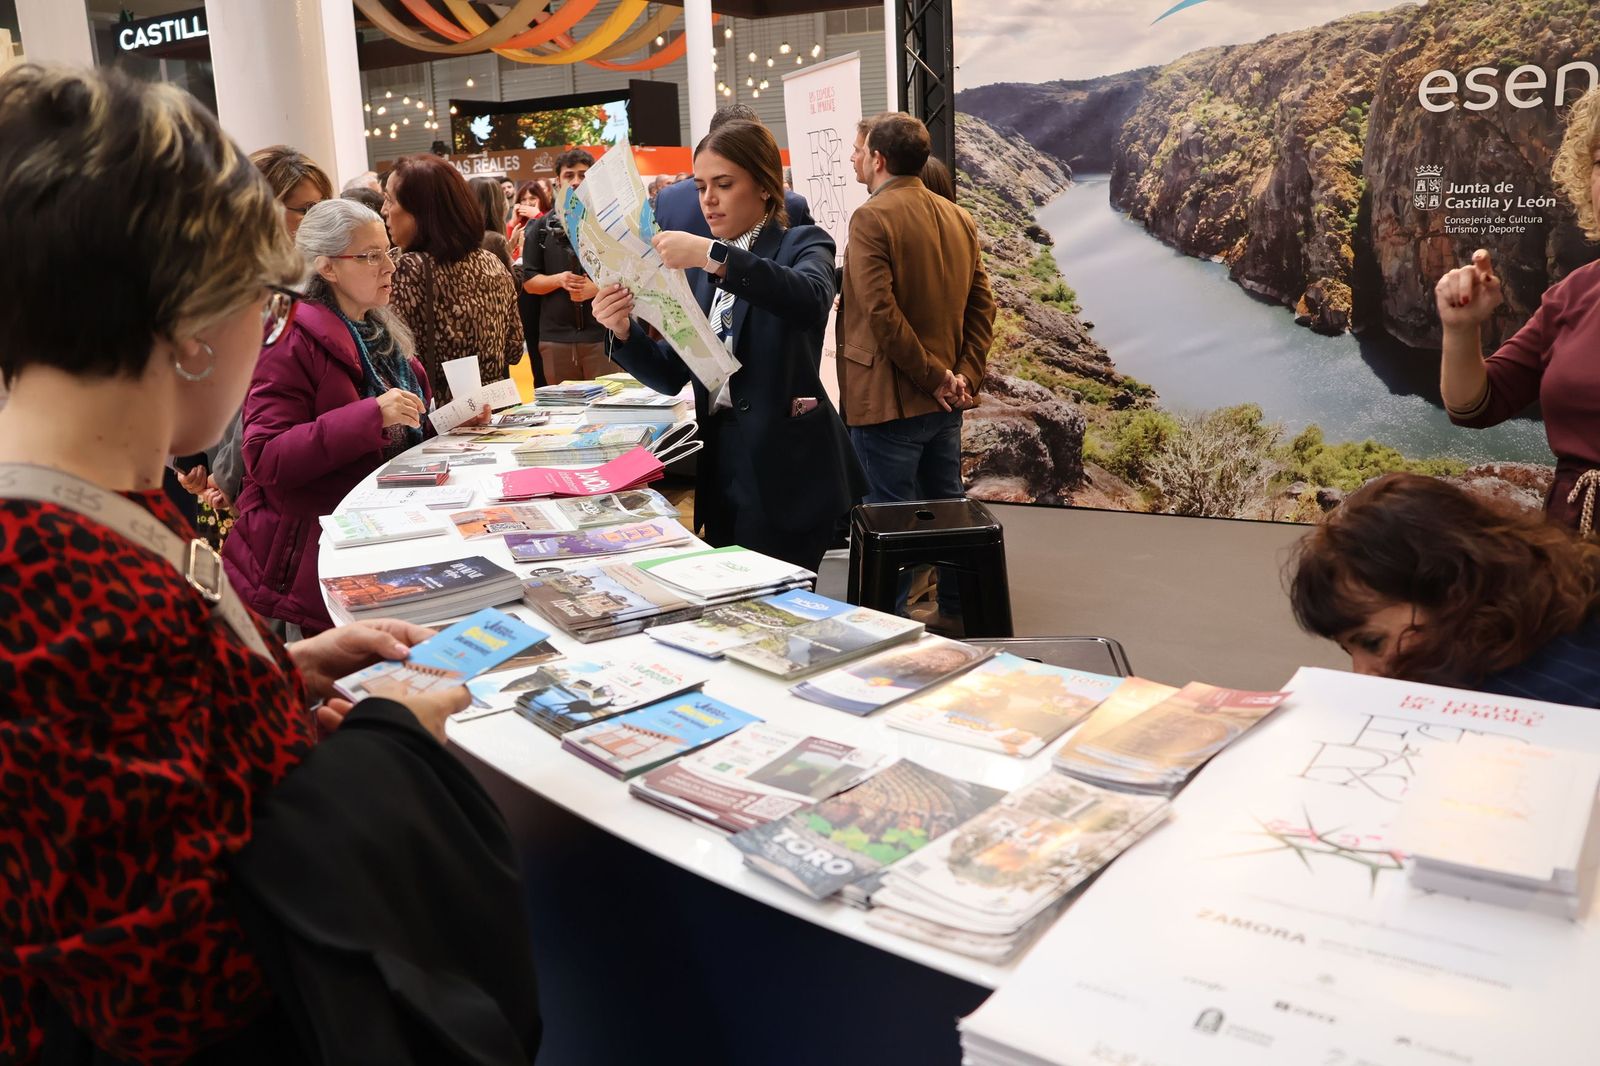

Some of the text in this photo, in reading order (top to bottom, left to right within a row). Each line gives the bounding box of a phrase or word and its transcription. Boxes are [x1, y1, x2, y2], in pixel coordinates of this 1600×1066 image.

[119, 15, 209, 51] CASTILL
[1418, 61, 1599, 113] esen
[473, 156, 520, 173] REALES
[1446, 181, 1514, 194] Junta de
[1445, 195, 1557, 212] Castilla y León
[1444, 215, 1543, 226] Consejería de Cultura
[1444, 226, 1479, 234] Turismo
[1489, 225, 1526, 235] Deporte
[772, 827, 853, 875] TORO
[1196, 907, 1306, 944] ZAMORA
